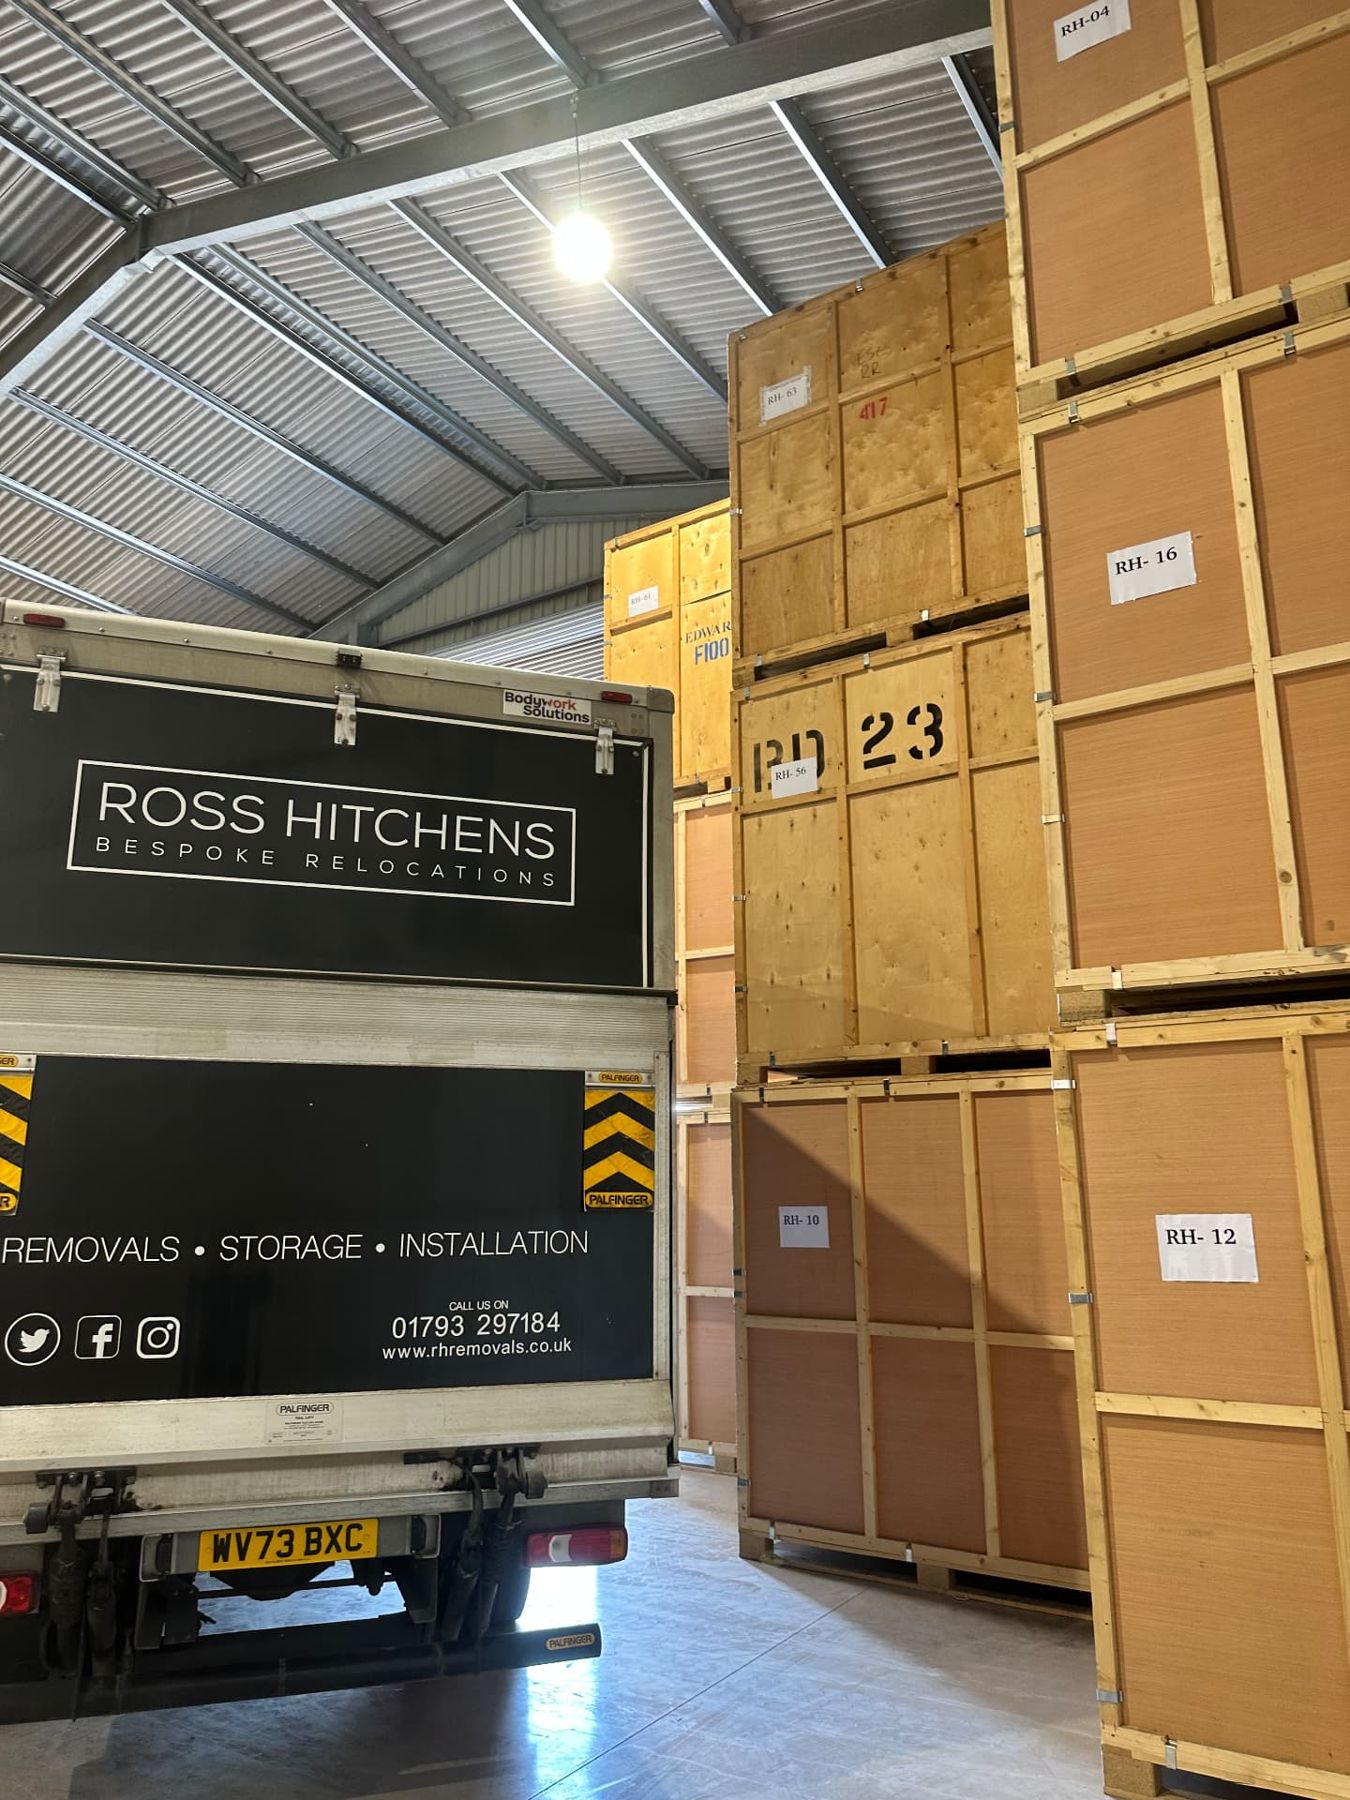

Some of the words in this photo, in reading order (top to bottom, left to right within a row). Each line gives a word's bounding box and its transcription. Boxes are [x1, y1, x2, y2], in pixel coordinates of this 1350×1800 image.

[1061, 5, 1110, 37] RH-04
[860, 396, 888, 420] 417
[1115, 556, 1149, 575] RH-
[1156, 546, 1178, 564] 16
[505, 691, 577, 710] Bodywork
[523, 705, 590, 723] Solutions
[861, 703, 944, 770] 23
[775, 771, 793, 781] RH-
[795, 767, 807, 777] 56
[99, 782, 265, 834] ROSS
[286, 799, 555, 859] HITCHENS
[96, 836, 275, 865] BESPOKE
[305, 853, 554, 886] RELOCATIONS
[601, 1073, 640, 1082] PALFINGER
[589, 1194, 649, 1206] PALFINGER
[784, 1215, 803, 1225] RH-
[807, 1214, 819, 1225] 10
[2, 1236, 180, 1263] REMOVALS
[219, 1234, 363, 1261] STORAGE
[400, 1230, 588, 1257] INSTALLATION
[1165, 1229, 1204, 1245] RH-
[1211, 1228, 1237, 1245] 12
[449, 1301, 474, 1312] CALL
[477, 1300, 491, 1310] US
[493, 1300, 509, 1309] ON
[392, 1315, 465, 1339] 01793
[477, 1311, 560, 1336] 297184
[382, 1337, 572, 1359] www.rhremovals.co.uk
[280, 1404, 329, 1413] PALFINGER
[212, 1529, 294, 1563] WV73
[304, 1523, 363, 1556] BXC
[549, 1634, 593, 1648] PALFINGER
